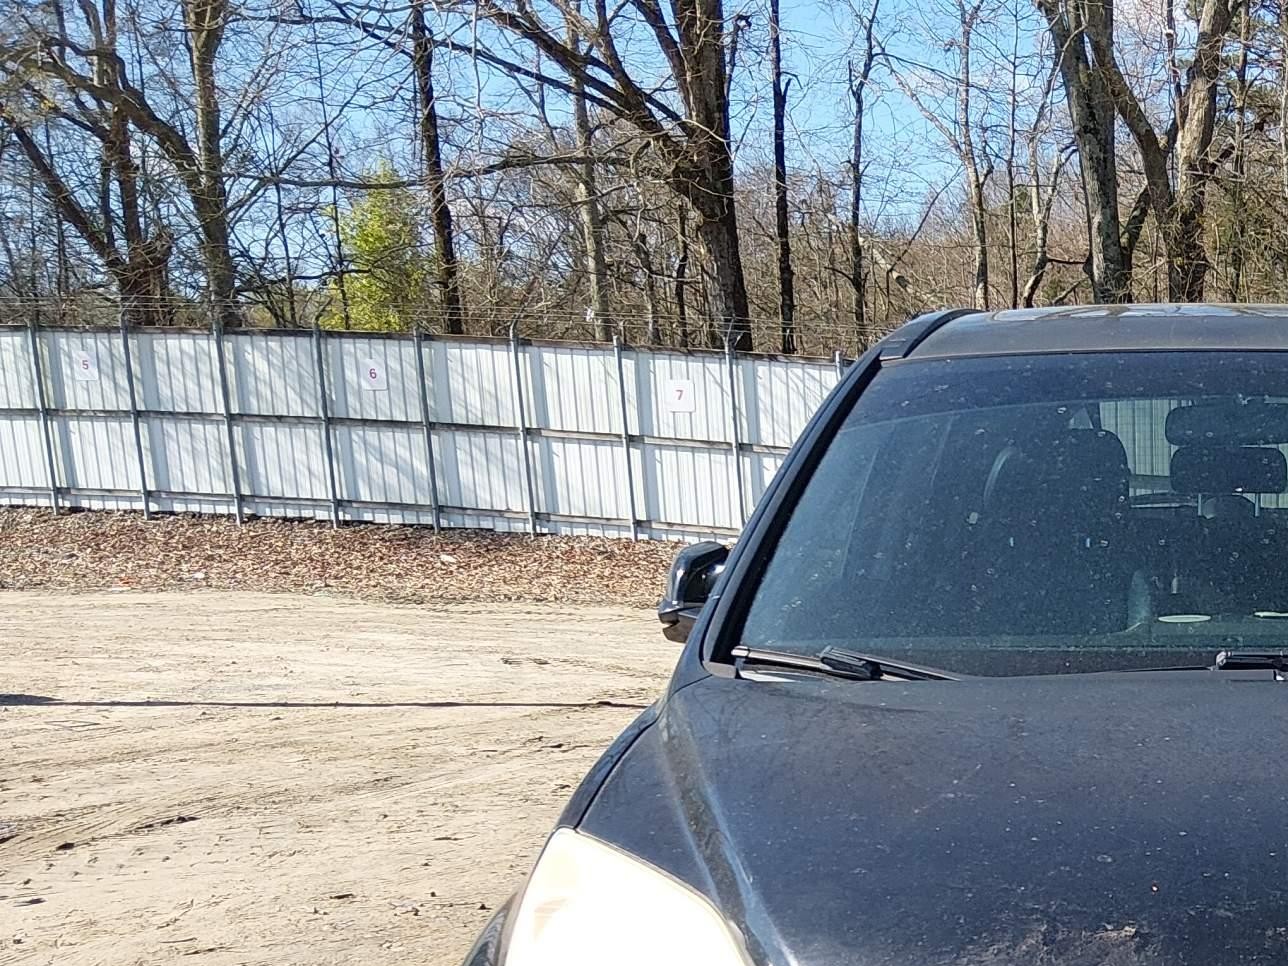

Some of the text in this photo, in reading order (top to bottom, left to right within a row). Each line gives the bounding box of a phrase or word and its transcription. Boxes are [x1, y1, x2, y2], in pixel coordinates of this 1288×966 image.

[82, 359, 89, 370] 5
[369, 367, 377, 380] 6
[675, 389, 684, 401] 7
